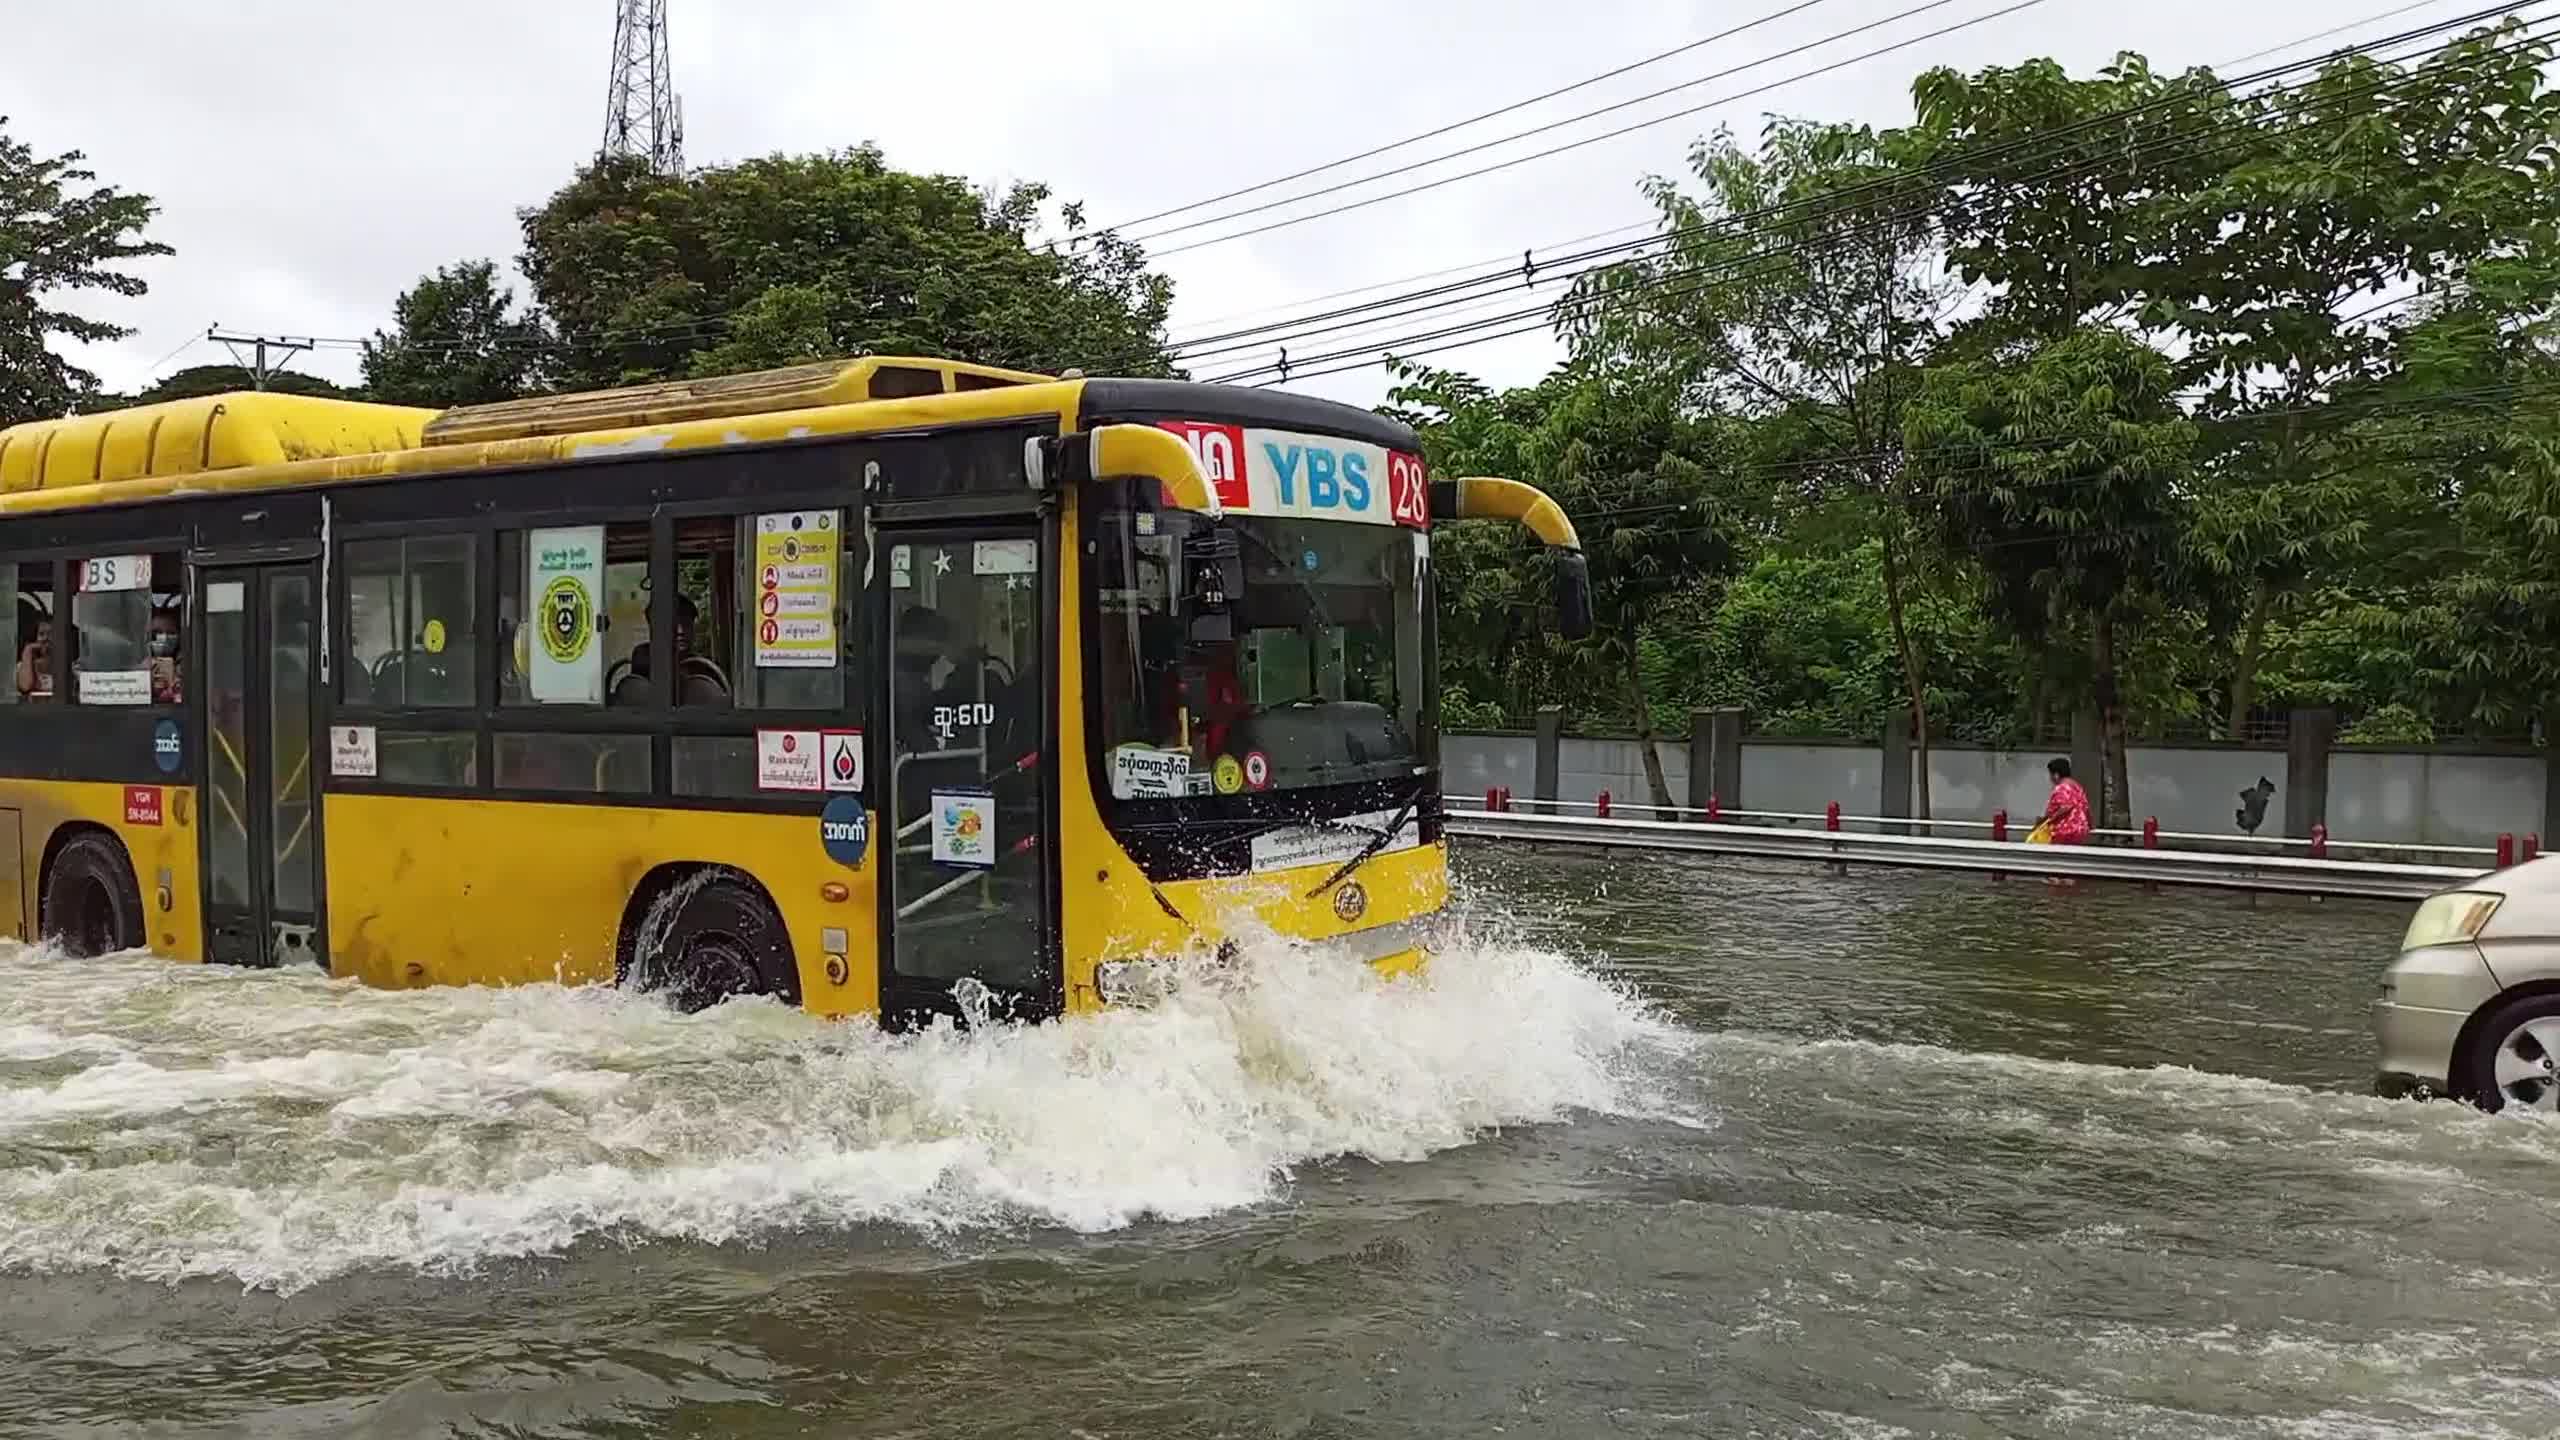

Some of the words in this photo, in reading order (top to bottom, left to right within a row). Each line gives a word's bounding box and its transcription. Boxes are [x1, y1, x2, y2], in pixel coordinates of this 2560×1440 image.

[1263, 442, 1371, 512] YBS
[1393, 457, 1425, 523] 28
[934, 703, 994, 737] ဆူးလေ
[823, 816, 866, 841] အတက်
